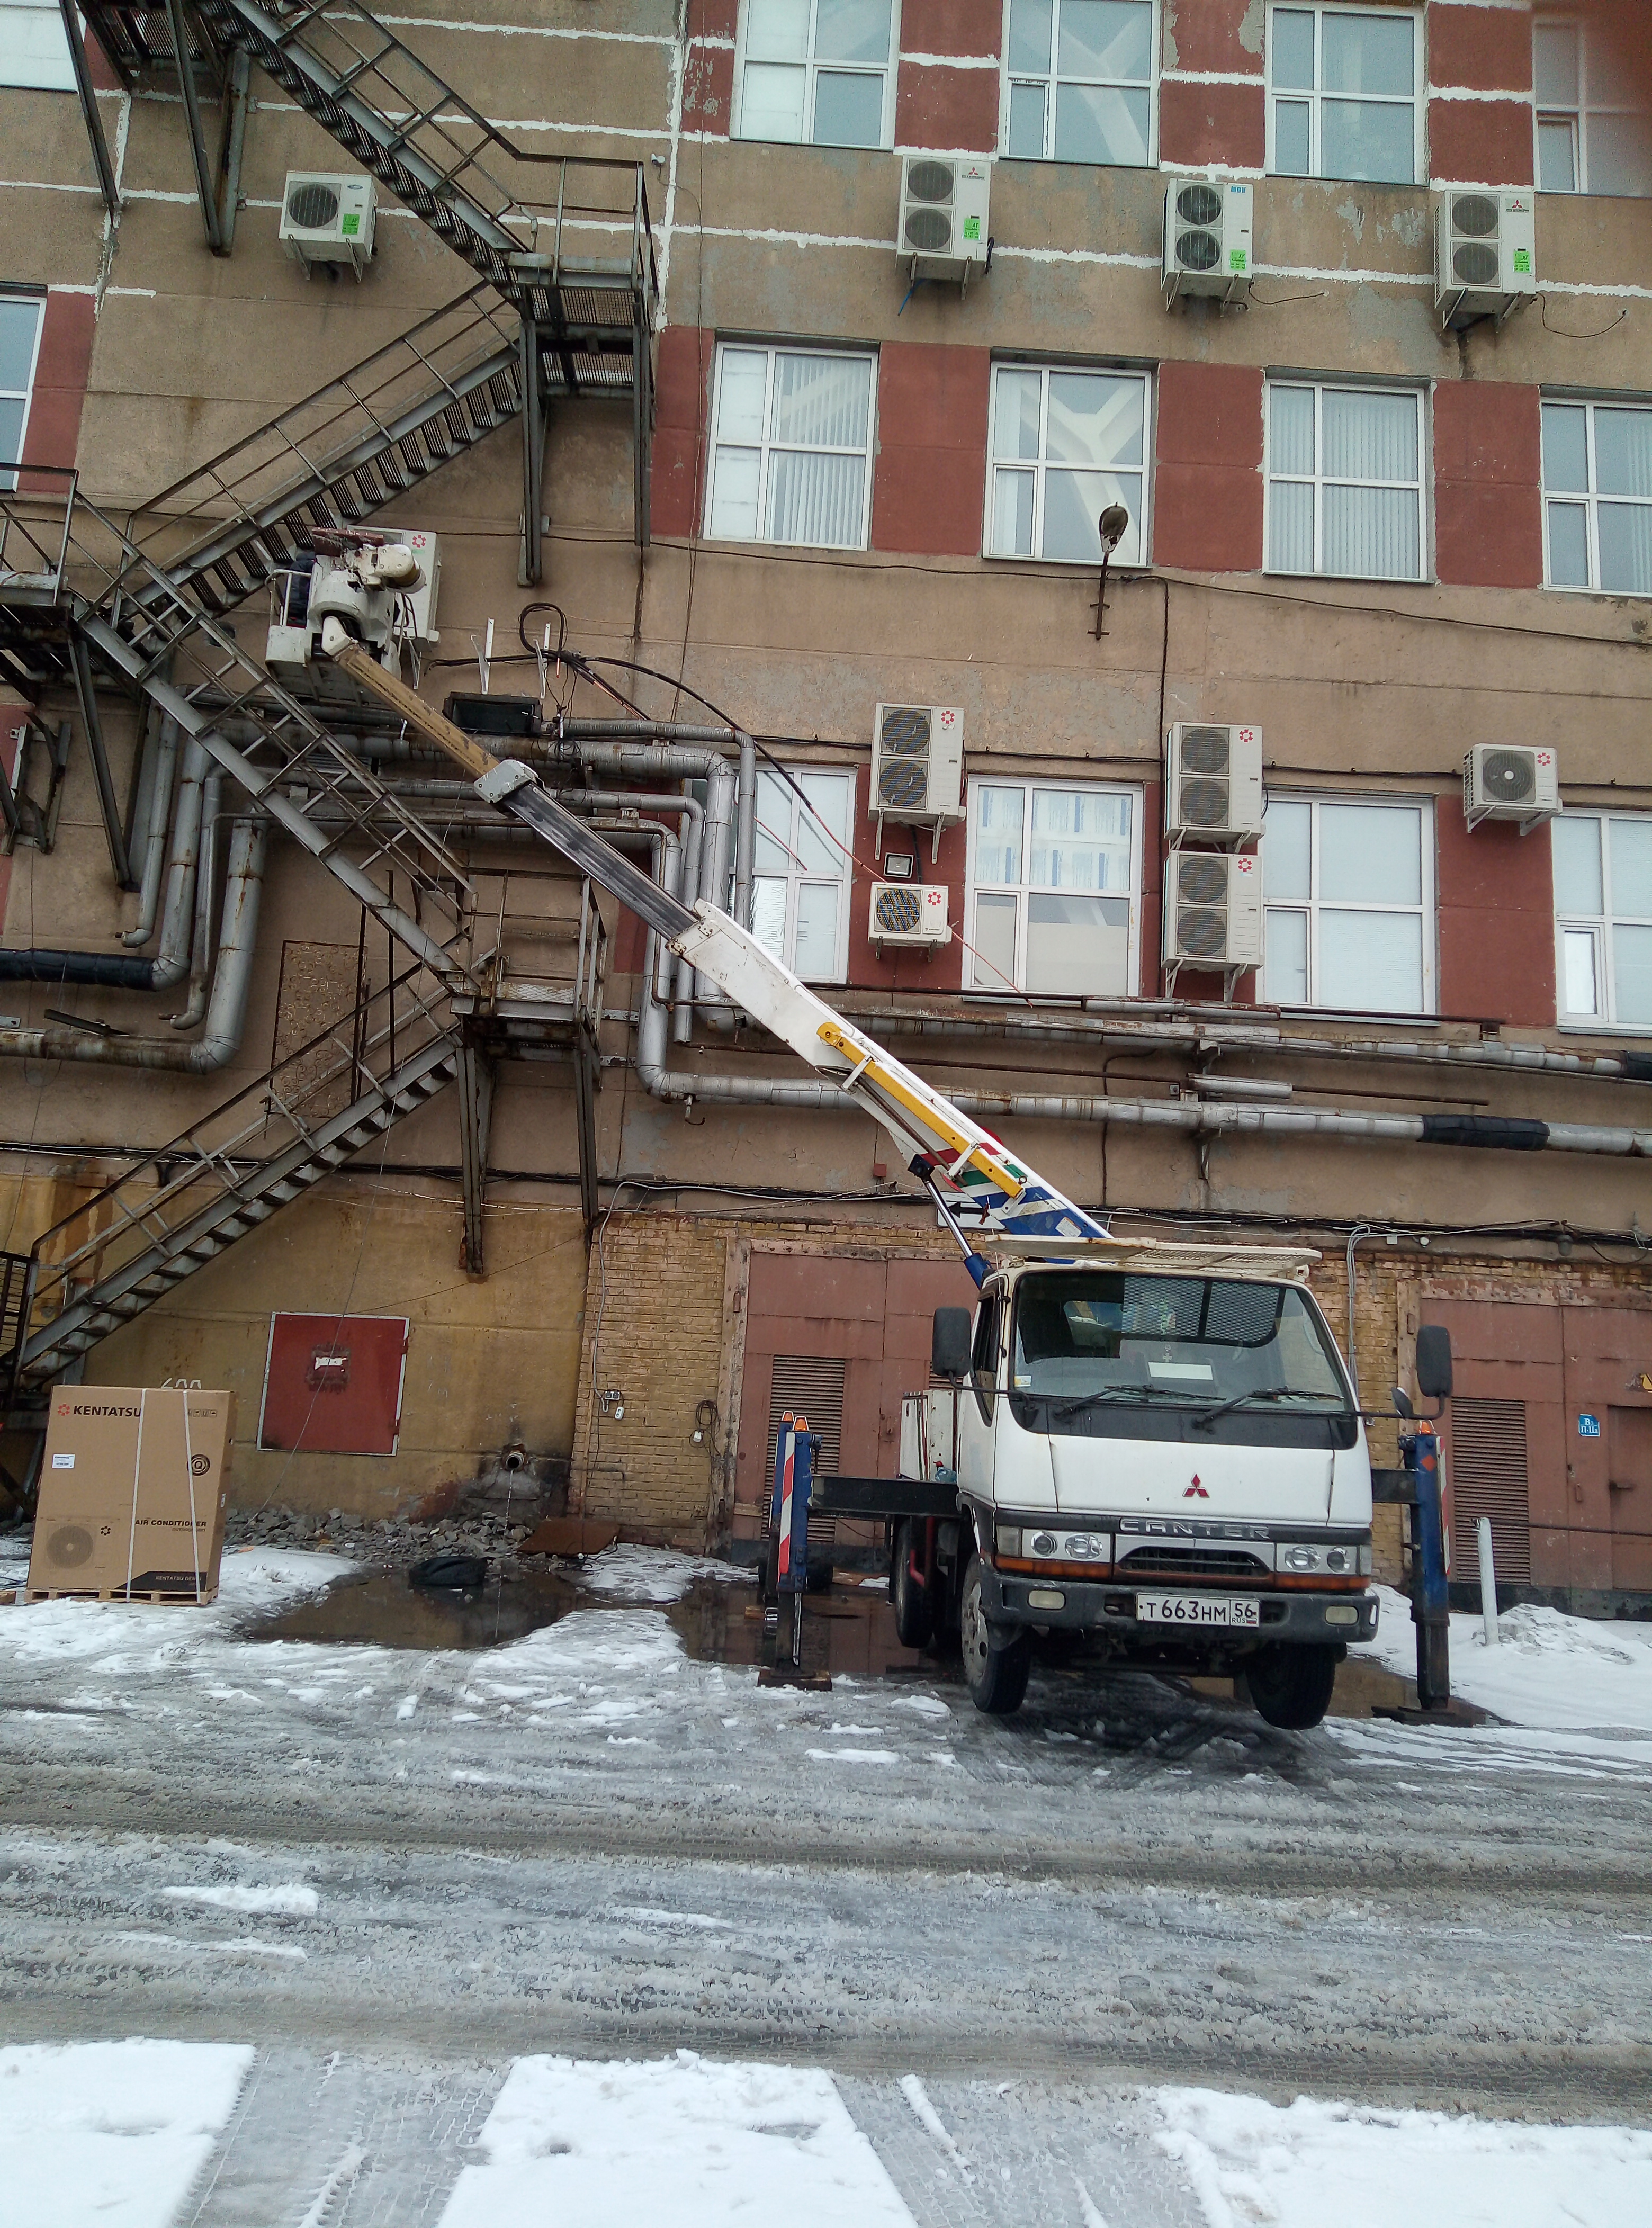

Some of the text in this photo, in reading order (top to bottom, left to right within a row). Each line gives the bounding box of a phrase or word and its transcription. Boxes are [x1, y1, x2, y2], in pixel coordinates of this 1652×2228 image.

[73, 1405, 141, 1417] KENTATSU
[1120, 1519, 1270, 1539] CANTER
[1234, 1603, 1253, 1618] 56
